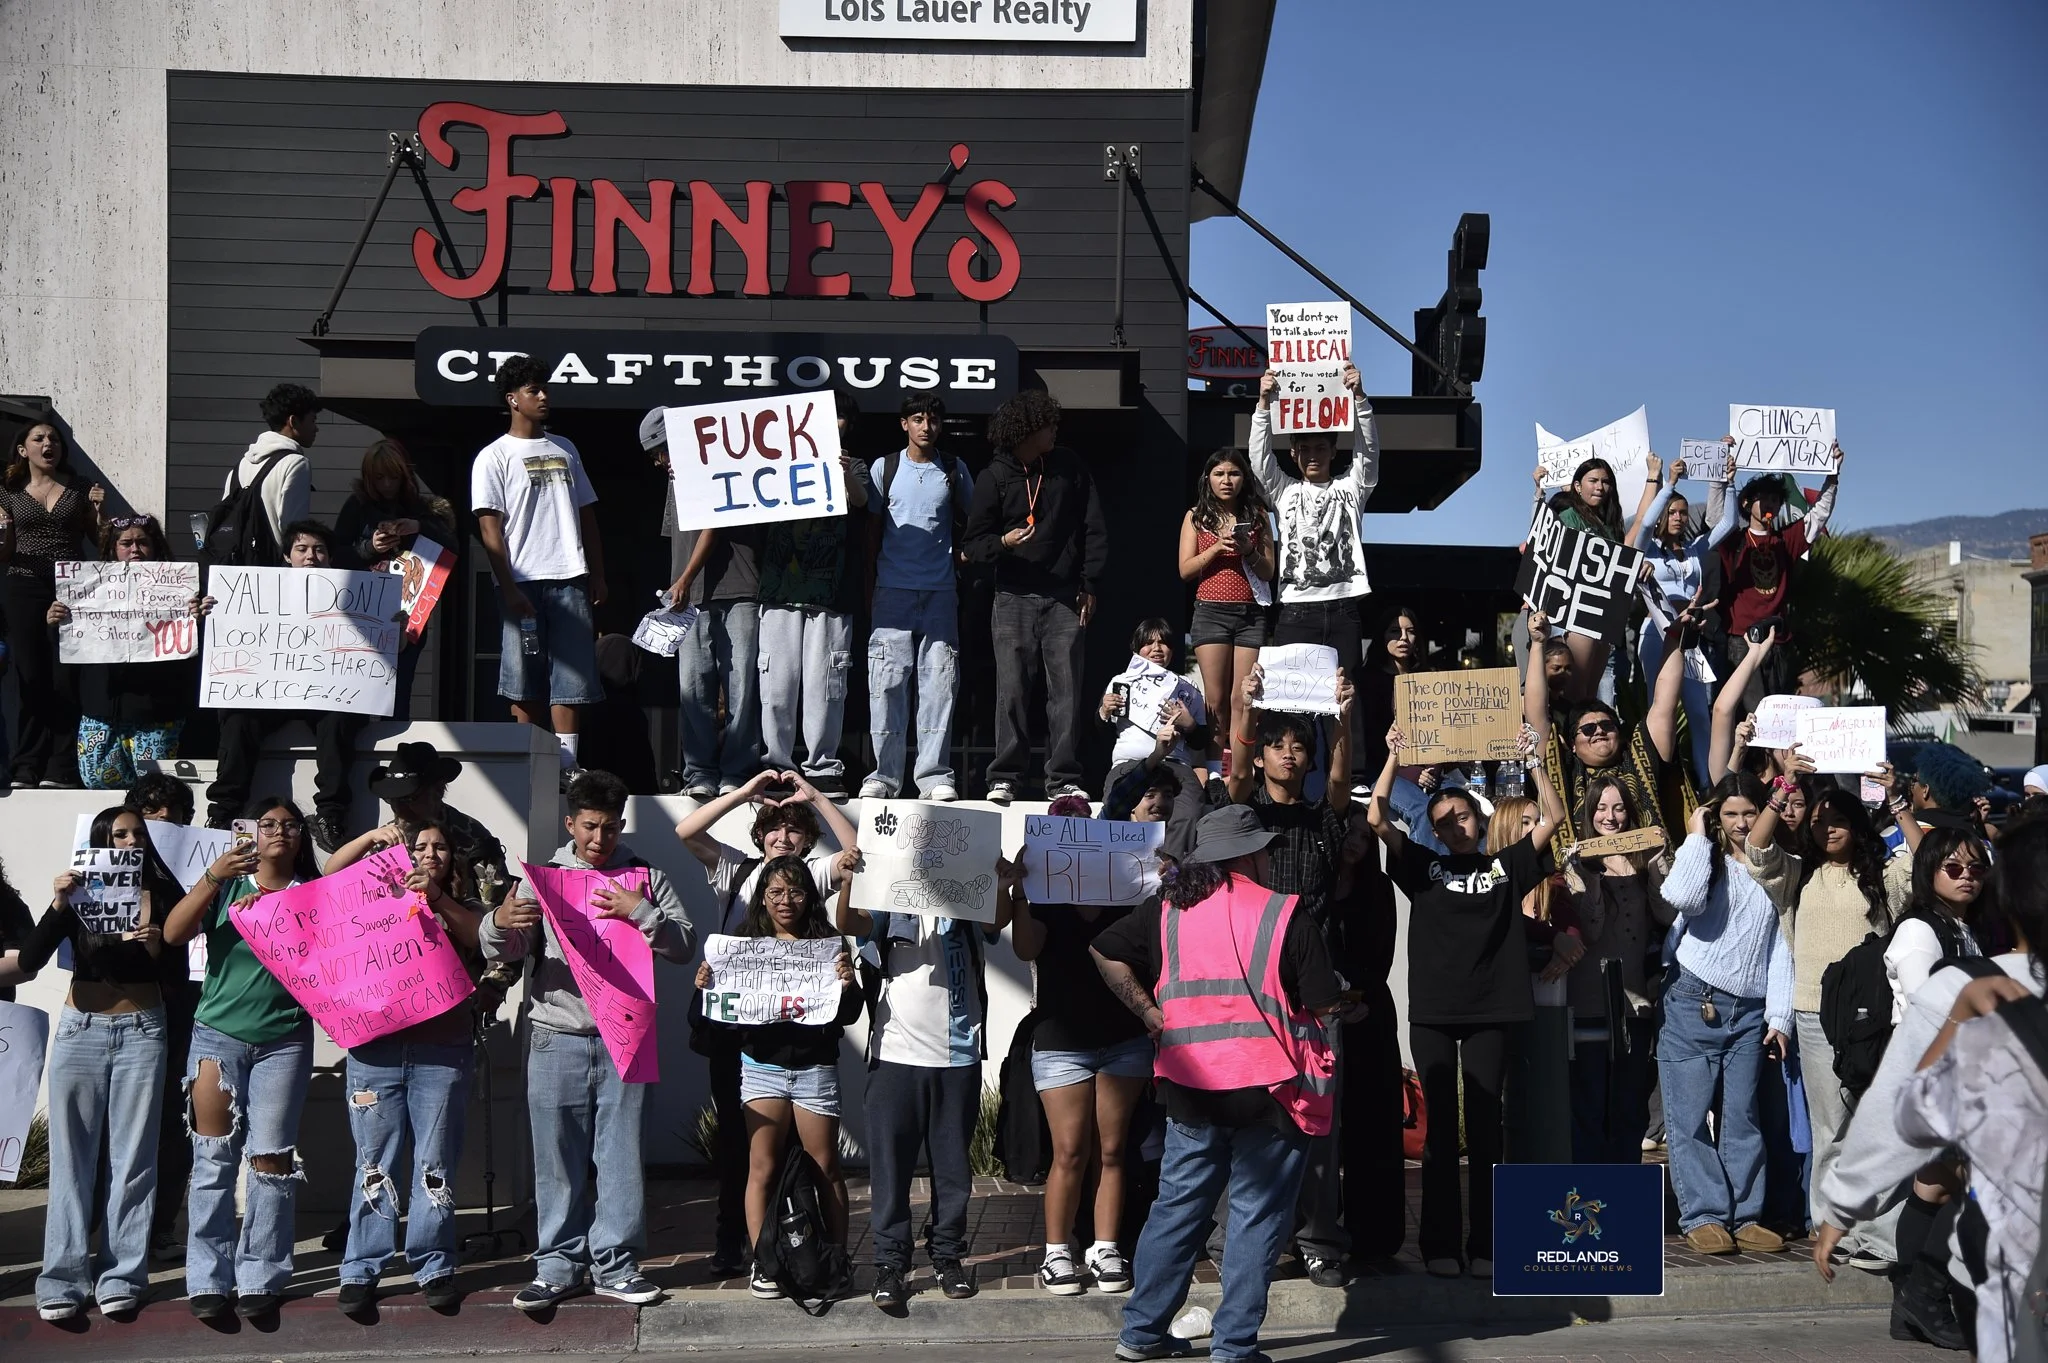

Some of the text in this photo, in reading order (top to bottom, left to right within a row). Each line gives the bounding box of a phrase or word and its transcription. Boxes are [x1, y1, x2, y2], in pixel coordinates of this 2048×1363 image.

[825, 0, 1091, 33] Lois Lauer Realty
[412, 101, 1021, 303] FINNEY'S
[1270, 309, 1294, 323] You
[1324, 314, 1339, 323] get
[1270, 326, 1281, 336] to
[1283, 327, 1300, 336] talk
[1303, 327, 1326, 337] about
[1188, 335, 1270, 368] FINNE
[1270, 338, 1350, 363] ILLEGAL
[1317, 368, 1339, 378] voted
[1288, 381, 1325, 393] for a
[1279, 397, 1349, 430] FELON
[1739, 408, 1822, 437] CHINGA
[694, 402, 819, 465] FUCK
[1541, 451, 1562, 464] ICE
[1551, 458, 1569, 470] NOT
[1683, 445, 1712, 460] ICE
[1768, 439, 1835, 470] MIGRA
[1526, 502, 1644, 594] ABOLISH
[56, 562, 81, 579] If
[68, 585, 96, 600] held
[108, 589, 126, 600] no
[220, 573, 392, 616] YALL DONT
[1522, 552, 1611, 640] ICE
[410, 594, 439, 626] UCK
[70, 625, 84, 639] to
[146, 619, 194, 657] YOU
[212, 618, 397, 649] LOOK FOR MISSING
[209, 651, 262, 672] KIDS
[270, 653, 325, 672] THIS
[1285, 647, 1330, 670] LIKE
[208, 680, 269, 703] FUCK
[1262, 668, 1336, 705] BOYS
[1403, 680, 1430, 695] The
[1465, 680, 1510, 703] thing
[1409, 697, 1505, 712] more POWERFUL
[1409, 712, 1434, 725] than
[1441, 712, 1479, 725] HATE
[1411, 729, 1440, 744] LOVE
[1025, 817, 1146, 844] We ALL bleed
[1607, 837, 1624, 847] GET
[1626, 834, 1644, 843] TF
[73, 849, 100, 867] IT
[109, 849, 144, 867] WAS
[1046, 849, 1144, 903] RED
[237, 901, 320, 939] We're
[327, 881, 361, 918] NOT
[247, 939, 309, 963] We're
[312, 922, 347, 951] NOT
[717, 940, 765, 955] USING
[772, 940, 795, 954] MY
[320, 951, 361, 986] NOT
[364, 932, 443, 976] Aliens,
[792, 960, 823, 974] RIGHT
[948, 926, 968, 1012] MESSI
[313, 1001, 332, 1015] are
[332, 982, 393, 1010] HUMANS
[397, 970, 425, 992] and
[712, 970, 824, 993] TO FIGHT FOR MY
[337, 968, 469, 1041] AMERICANS
